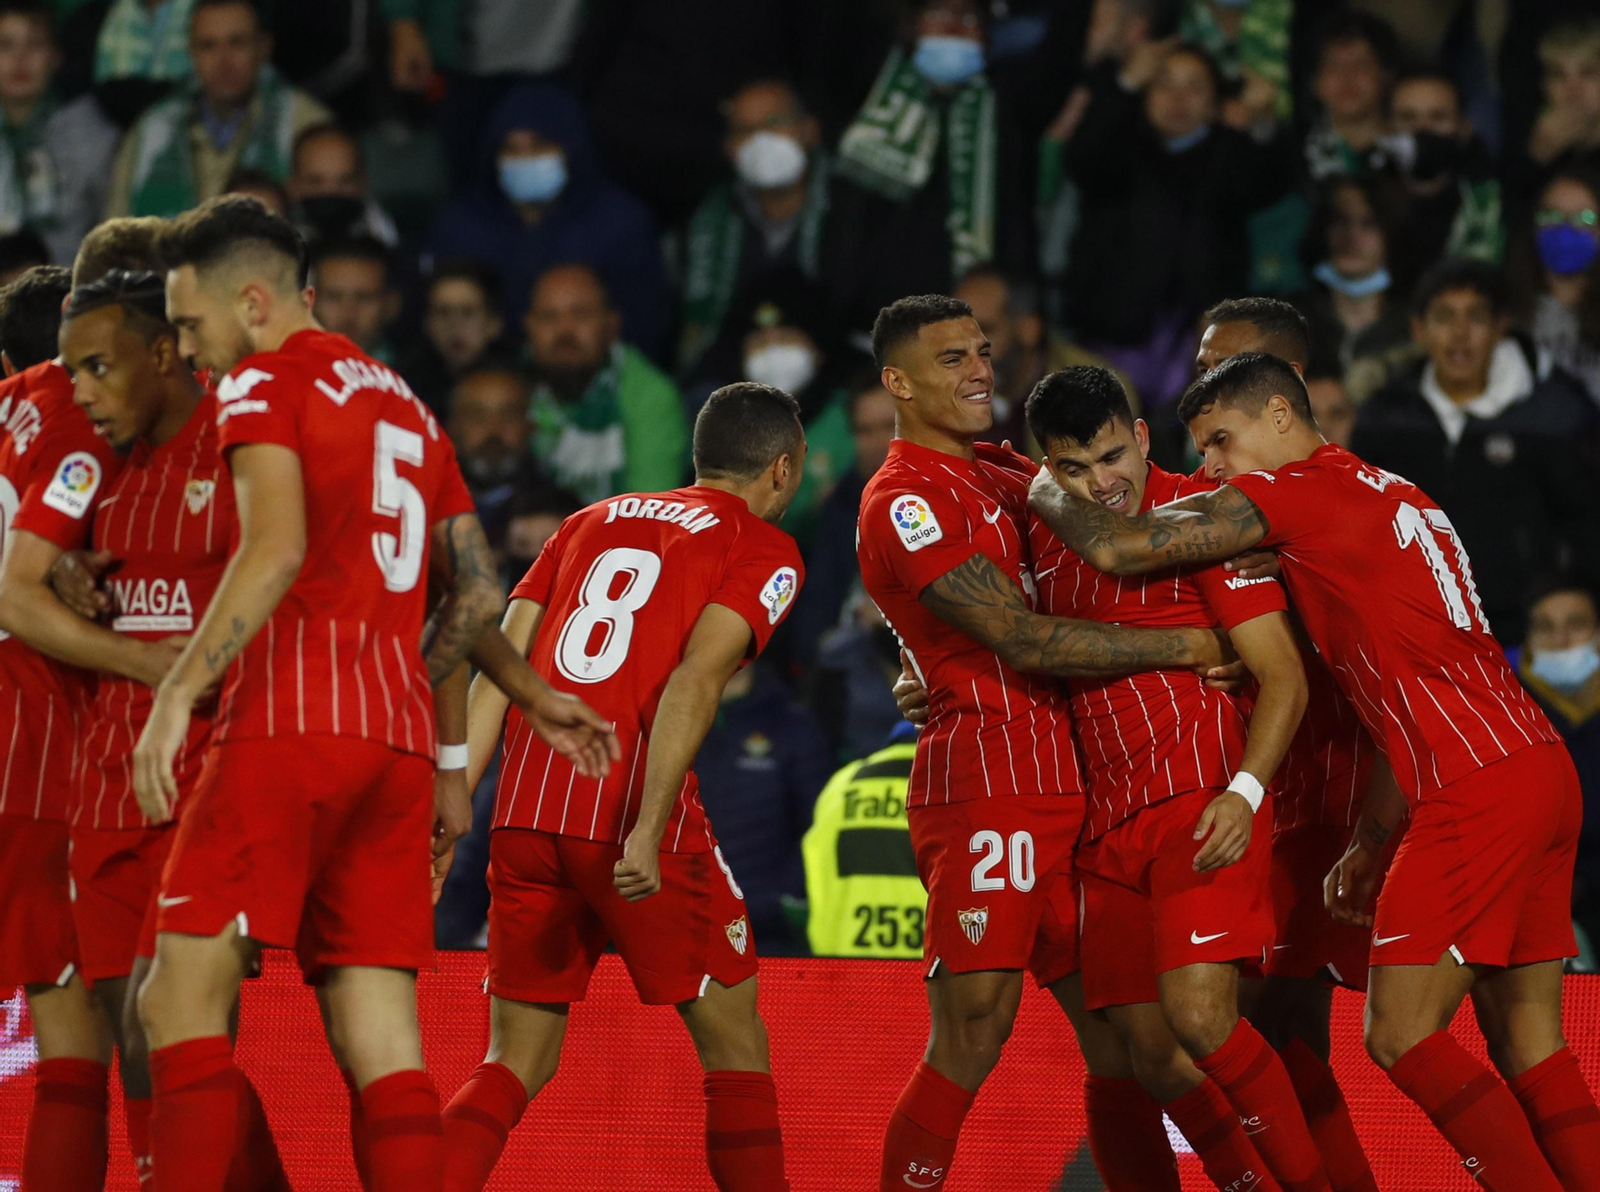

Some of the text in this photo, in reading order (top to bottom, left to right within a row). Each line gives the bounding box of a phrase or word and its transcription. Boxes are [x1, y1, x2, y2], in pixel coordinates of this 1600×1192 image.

[372, 419, 426, 592] 5
[604, 497, 720, 534] JORDÁN
[905, 525, 936, 544] LaLiga
[1391, 501, 1491, 635] 17
[115, 578, 193, 614] NAGA
[554, 547, 661, 684] 8
[969, 829, 1036, 893] 20
[854, 905, 924, 949] 253
[908, 1161, 943, 1178] SFC
